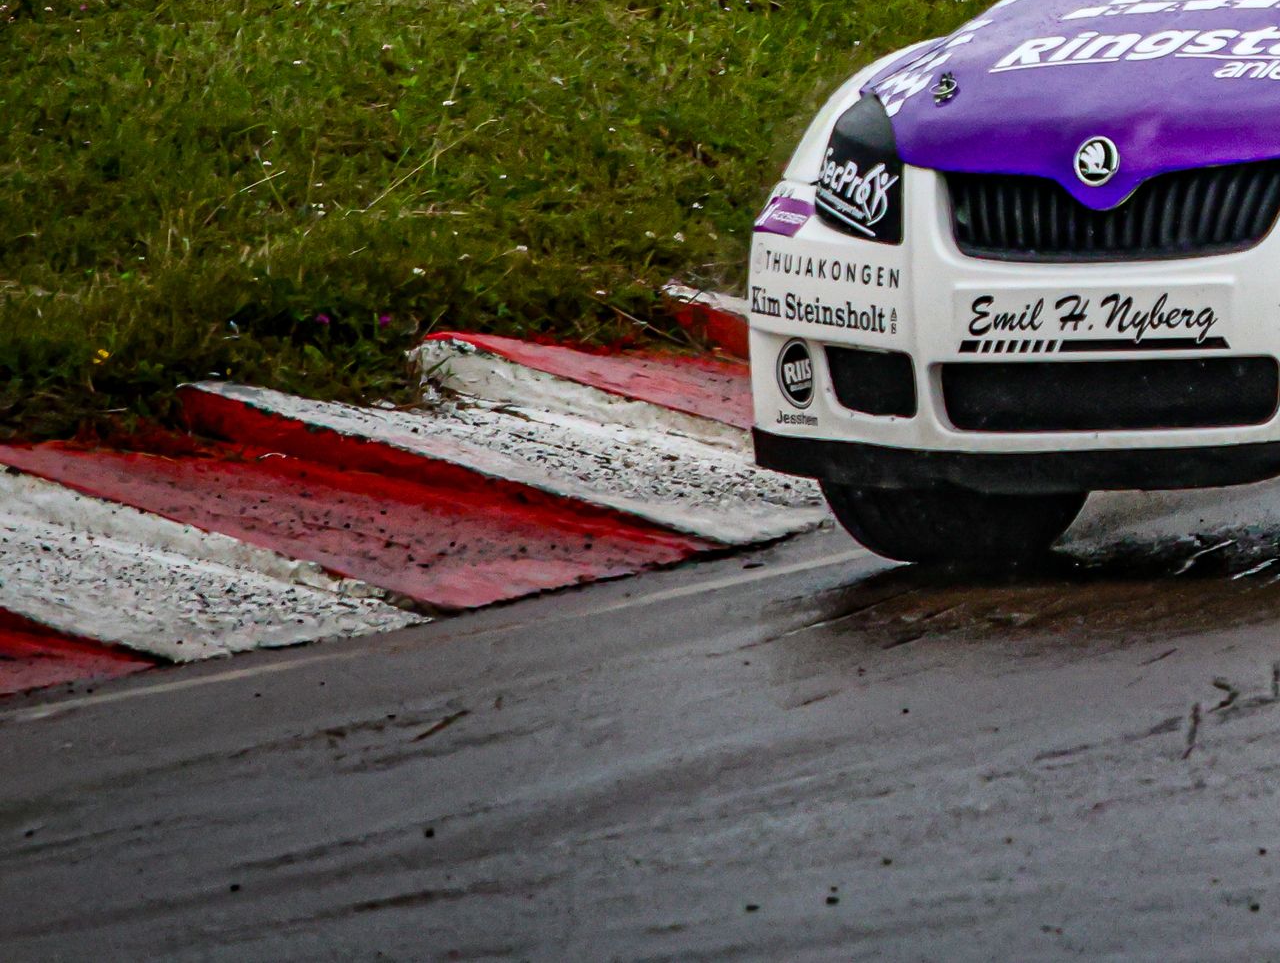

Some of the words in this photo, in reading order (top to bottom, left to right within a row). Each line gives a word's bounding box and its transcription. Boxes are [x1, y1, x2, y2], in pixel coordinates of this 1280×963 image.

[766, 250, 900, 289] THUJAKONGEN
[751, 286, 781, 318] Kim
[785, 292, 886, 334] Steinsholt
[969, 294, 1044, 336] Emil
[1055, 294, 1094, 331] H.
[1100, 292, 1219, 344] Nyberg
